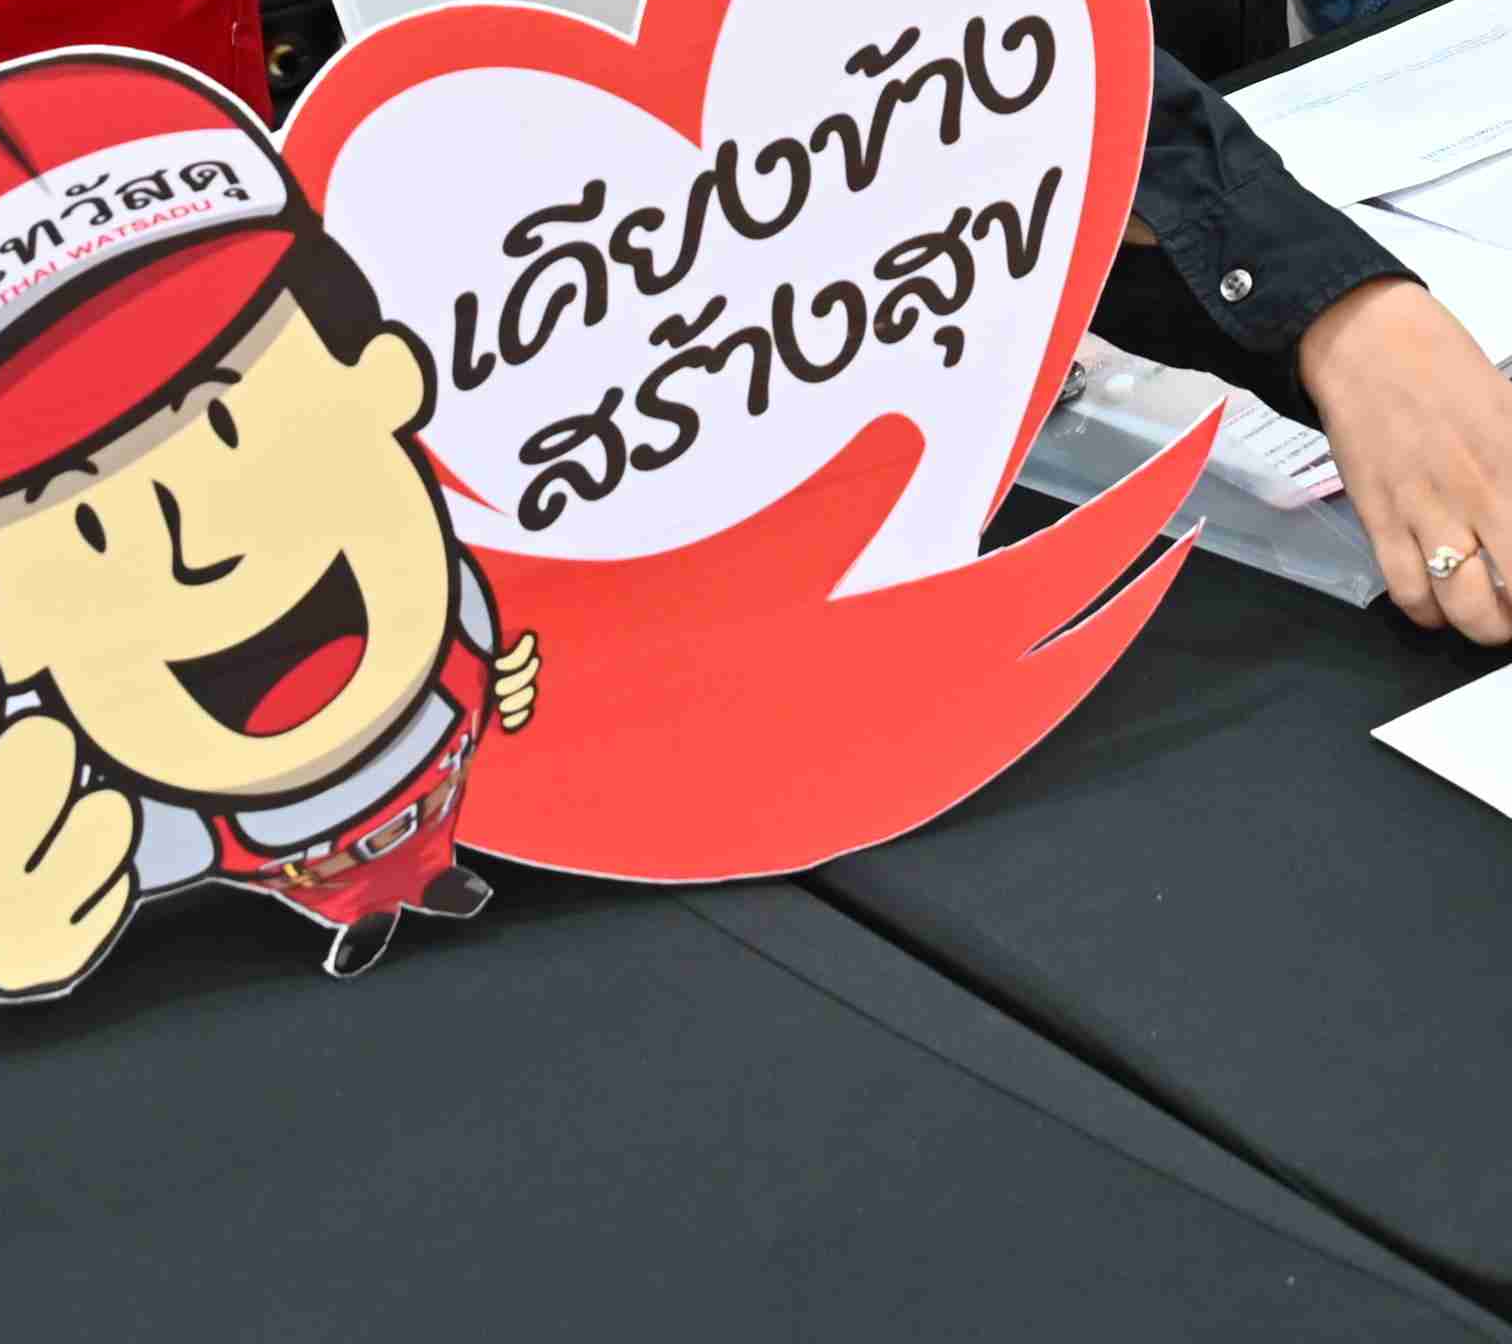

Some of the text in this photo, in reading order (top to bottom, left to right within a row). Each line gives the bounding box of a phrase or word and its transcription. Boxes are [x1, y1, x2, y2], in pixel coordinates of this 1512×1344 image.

[67, 198, 212, 259] WATSADU
[448, 13, 1058, 392] เคียงข้าง
[517, 166, 1064, 533] สร้างสุข
